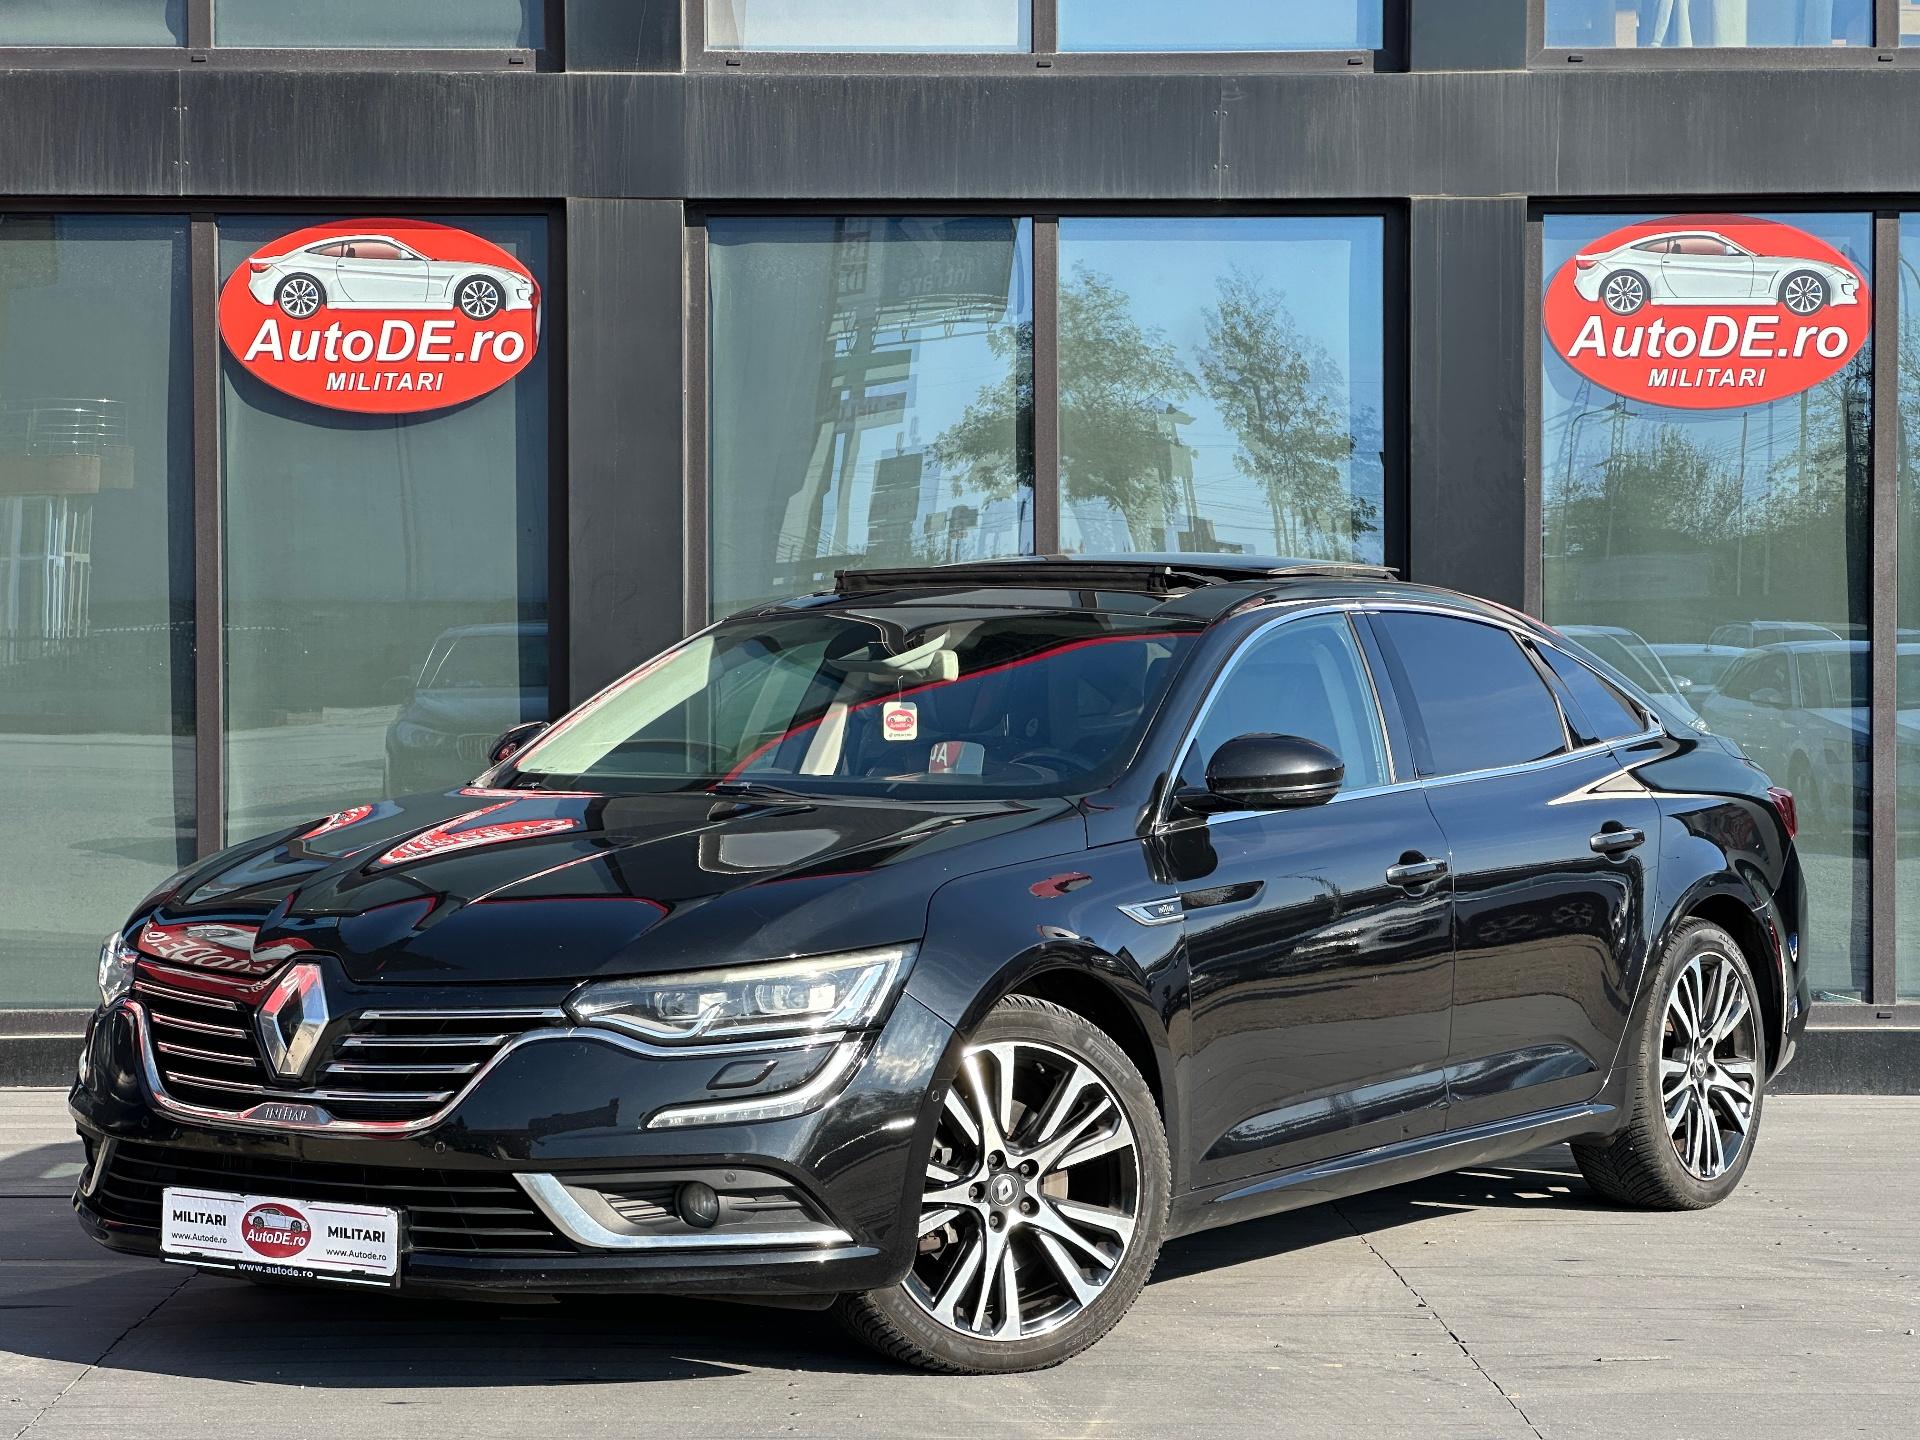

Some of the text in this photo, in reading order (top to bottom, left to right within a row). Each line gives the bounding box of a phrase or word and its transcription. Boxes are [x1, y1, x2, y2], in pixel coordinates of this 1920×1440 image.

[243, 319, 525, 363] AutoDE.ro
[1567, 315, 1849, 358] AutoDE.ro
[325, 372, 443, 391] MILITARI
[1648, 368, 1766, 387] MILITARI
[172, 1209, 227, 1227] MILITARI
[171, 1231, 228, 1244] www.Autode.ro
[246, 1230, 307, 1247] AutoDE.ro
[327, 1225, 386, 1243] MILITARI
[325, 1248, 387, 1261] www.Autode.ro
[238, 1262, 314, 1278] www.autode.ro
